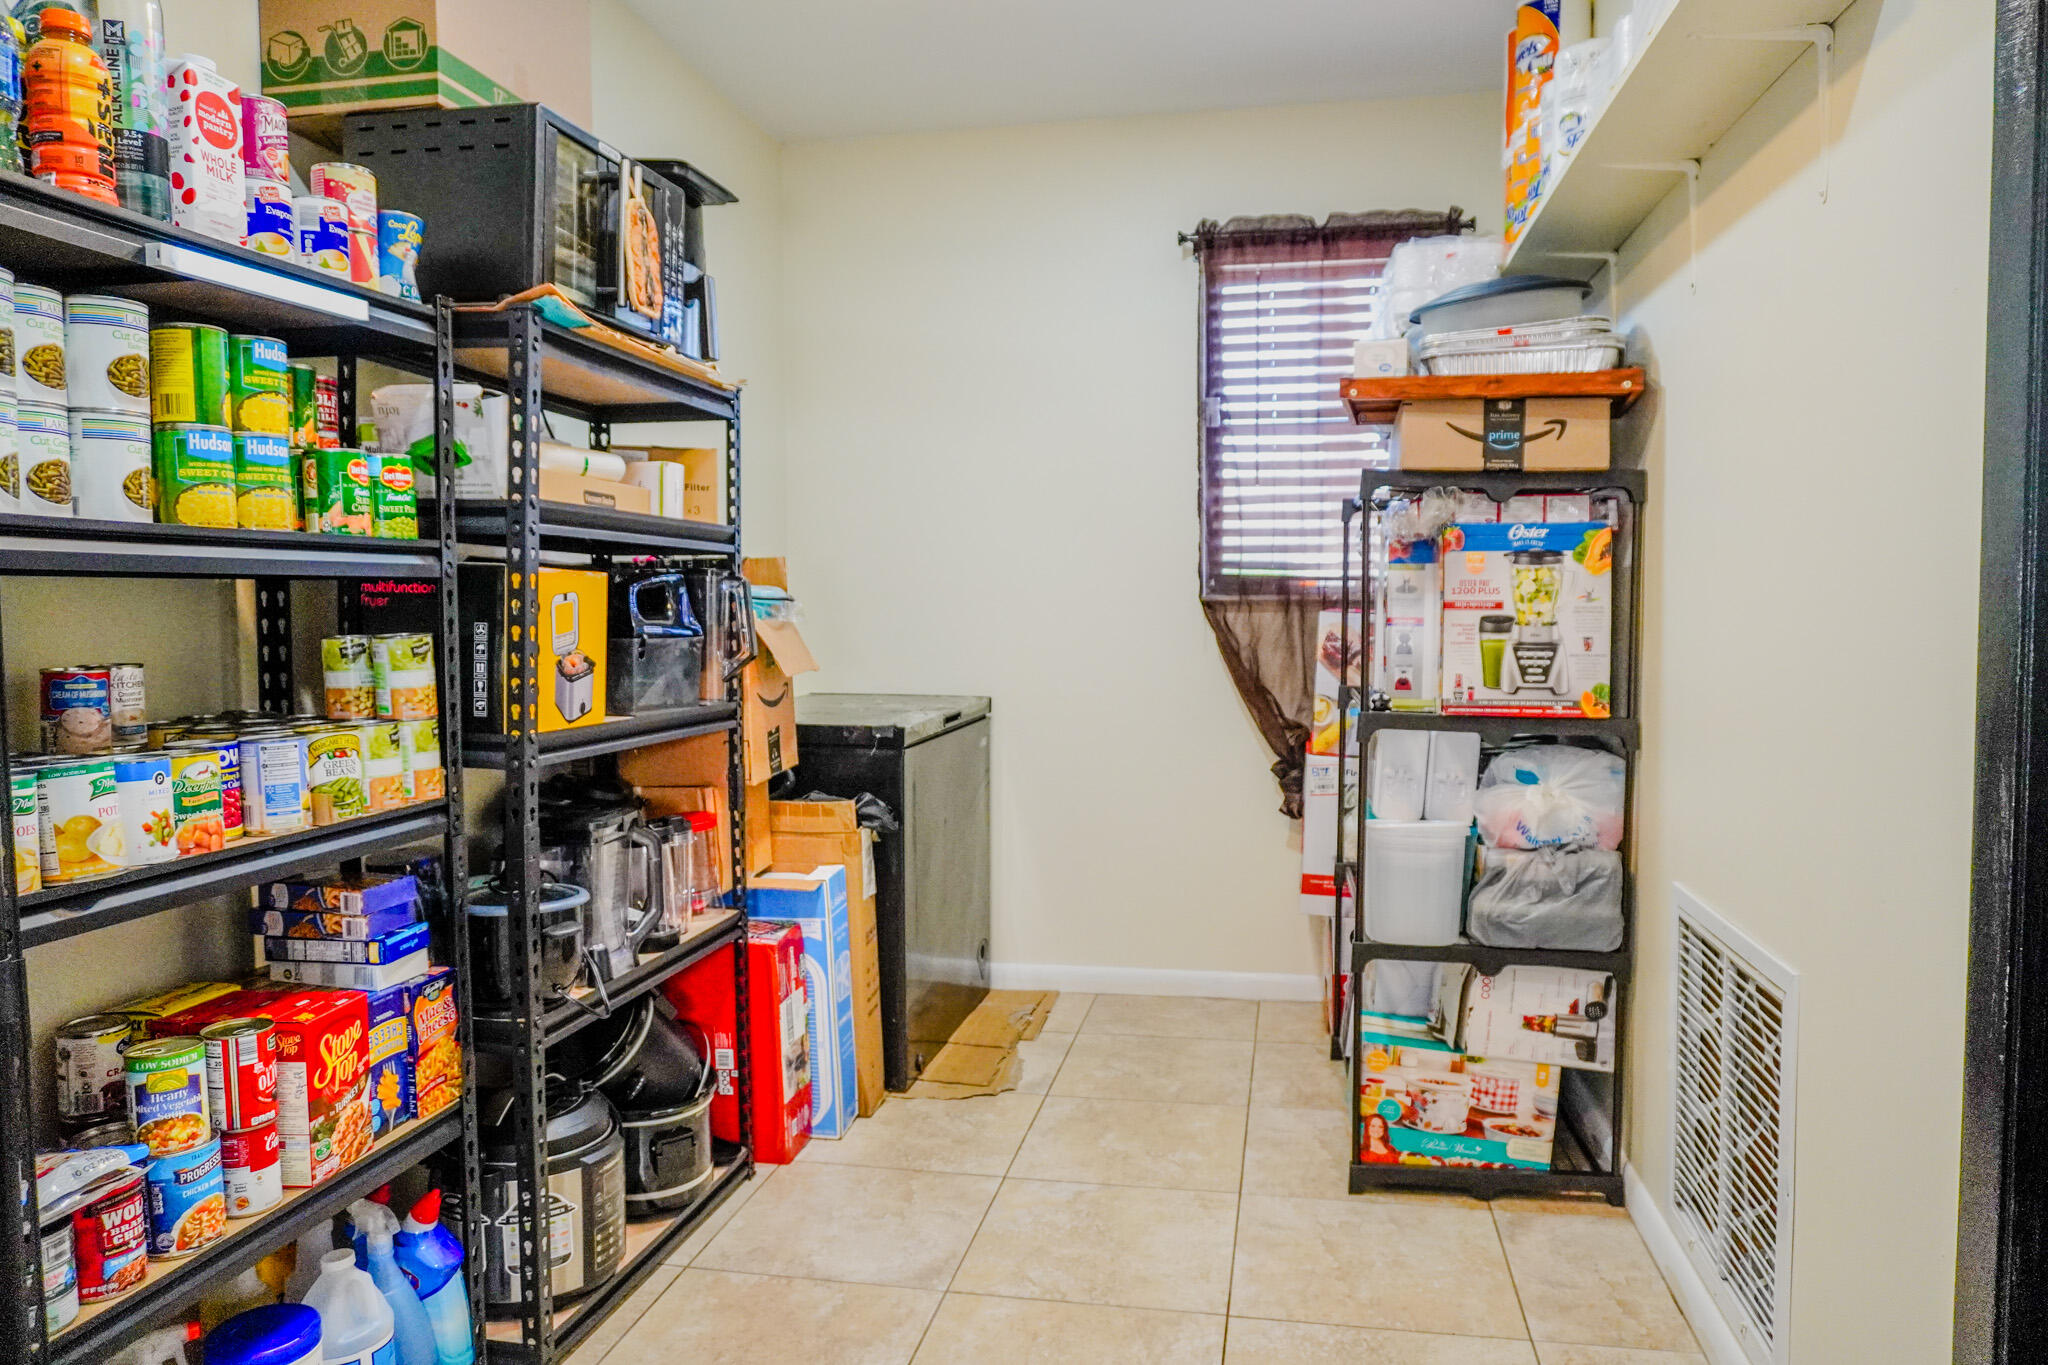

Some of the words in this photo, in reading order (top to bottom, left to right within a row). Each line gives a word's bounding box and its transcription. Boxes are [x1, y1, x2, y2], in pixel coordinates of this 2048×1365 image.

[106, 48, 122, 124] ALKALINE
[198, 109, 232, 129] modern
[203, 120, 234, 140] pantry
[118, 137, 142, 146] Level
[201, 149, 237, 174] WHOLE
[206, 164, 234, 184] MILK
[188, 433, 232, 453] Hudson
[1489, 429, 1520, 441] prime
[246, 439, 289, 458] Hudson
[179, 468, 219, 477] SWEET
[237, 472, 274, 481] SWEET
[684, 483, 710, 491] Filter
[1509, 523, 1550, 540] Oster
[361, 580, 436, 594] multifunction
[361, 594, 390, 610] fryer
[323, 759, 356, 769] GREEN
[326, 768, 356, 776] BEANS
[419, 1003, 440, 1024] Mac
[418, 1007, 456, 1045] Cheese
[276, 1032, 301, 1049] Stove
[283, 1043, 298, 1056] Top
[135, 1061, 160, 1071] LOW
[161, 1052, 198, 1068] SODIUM
[314, 1019, 362, 1089] Stove
[333, 1050, 358, 1093] Top
[150, 1087, 189, 1103] Hearty
[335, 1085, 359, 1114] TURKEY
[136, 1103, 160, 1114] Mixed
[179, 1150, 221, 1184] PROGRESS
[182, 1182, 208, 1199] CHICKEN
[102, 1199, 144, 1229] WOL
[110, 1218, 144, 1236] BRAN
[113, 1226, 145, 1245] CHIL
